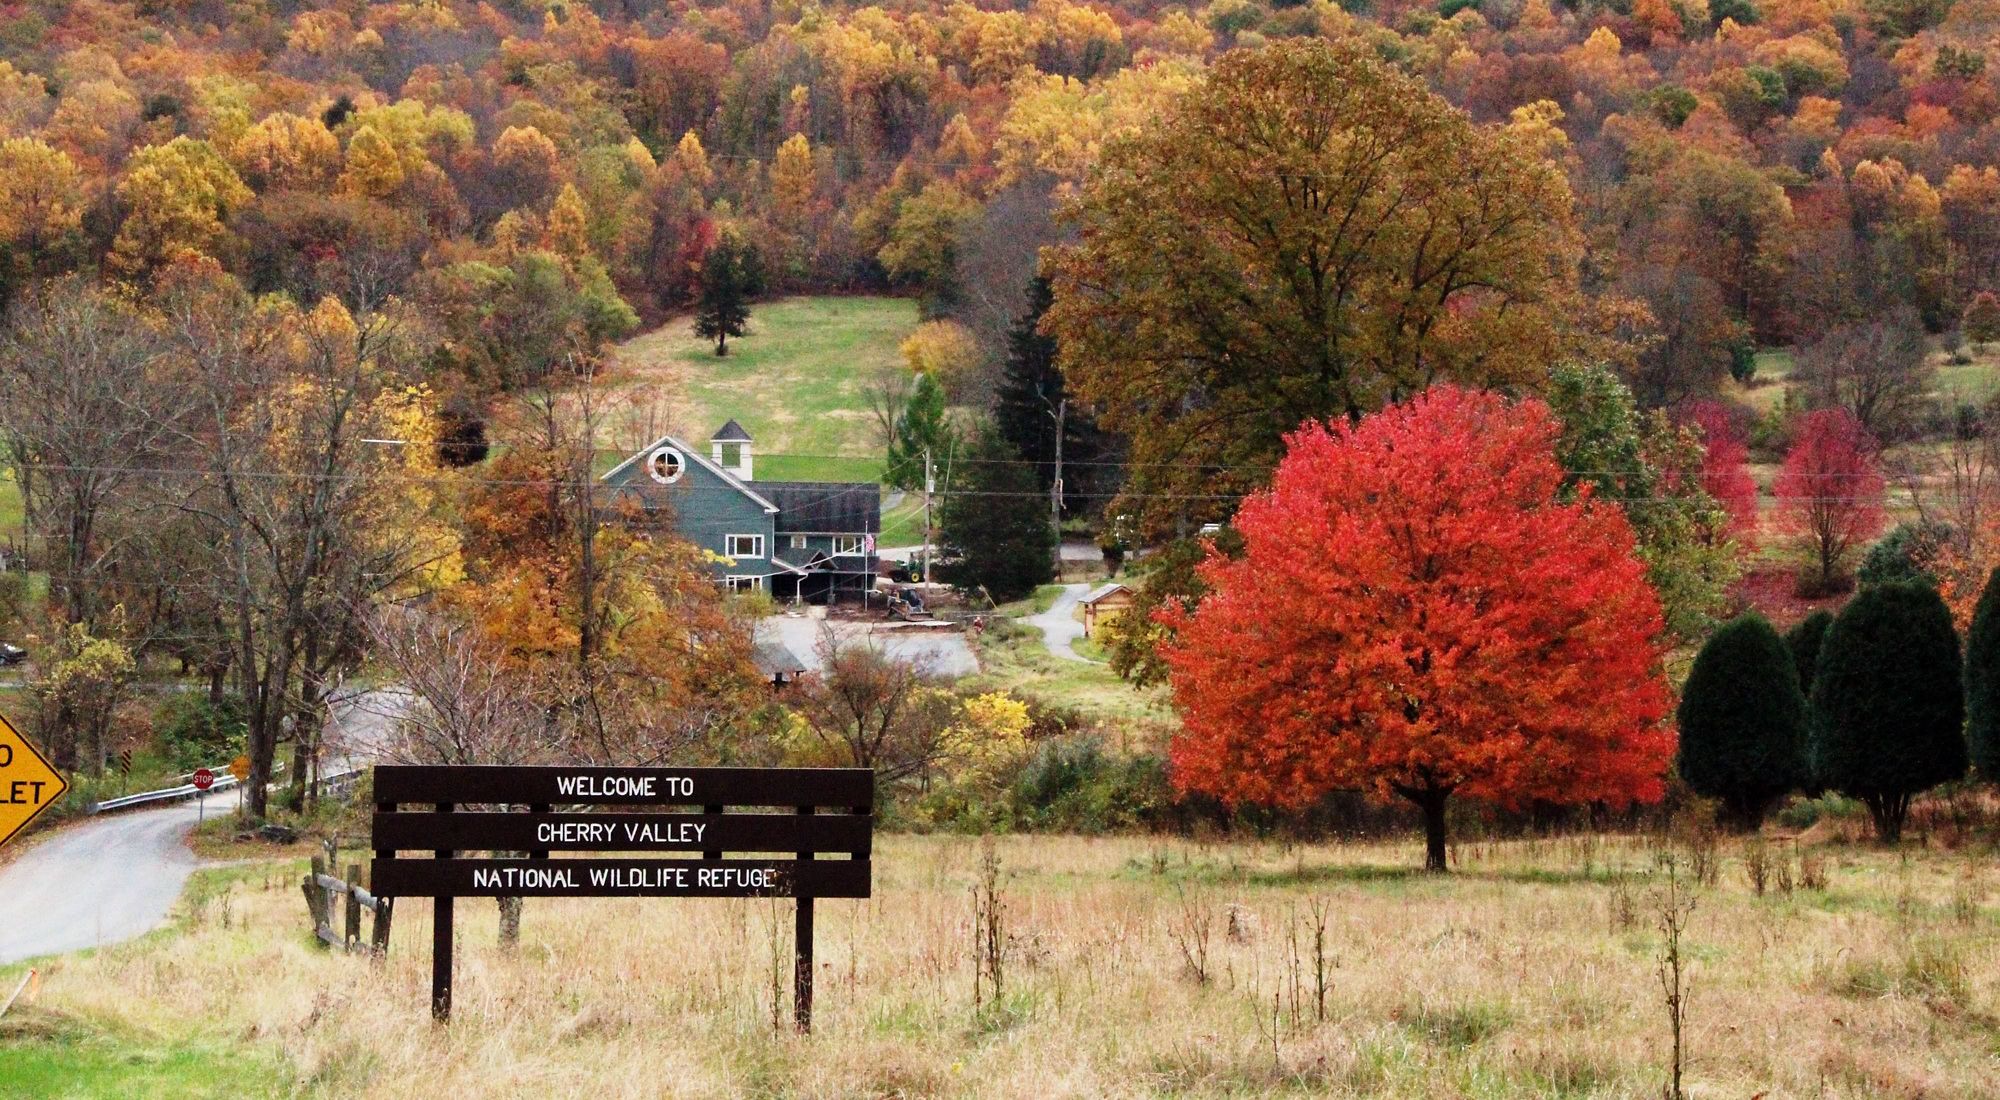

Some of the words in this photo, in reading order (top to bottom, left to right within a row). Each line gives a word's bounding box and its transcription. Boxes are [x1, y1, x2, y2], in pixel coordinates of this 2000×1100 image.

[194, 775, 213, 784] STOP
[557, 776, 657, 796] WELCOME
[666, 777, 694, 796] TO
[537, 823, 616, 842] CHERRY
[625, 823, 707, 842] VALLEY
[474, 868, 580, 888] NATIONAL
[590, 868, 689, 888] WILDLIFE
[698, 868, 776, 887] REFUGE
